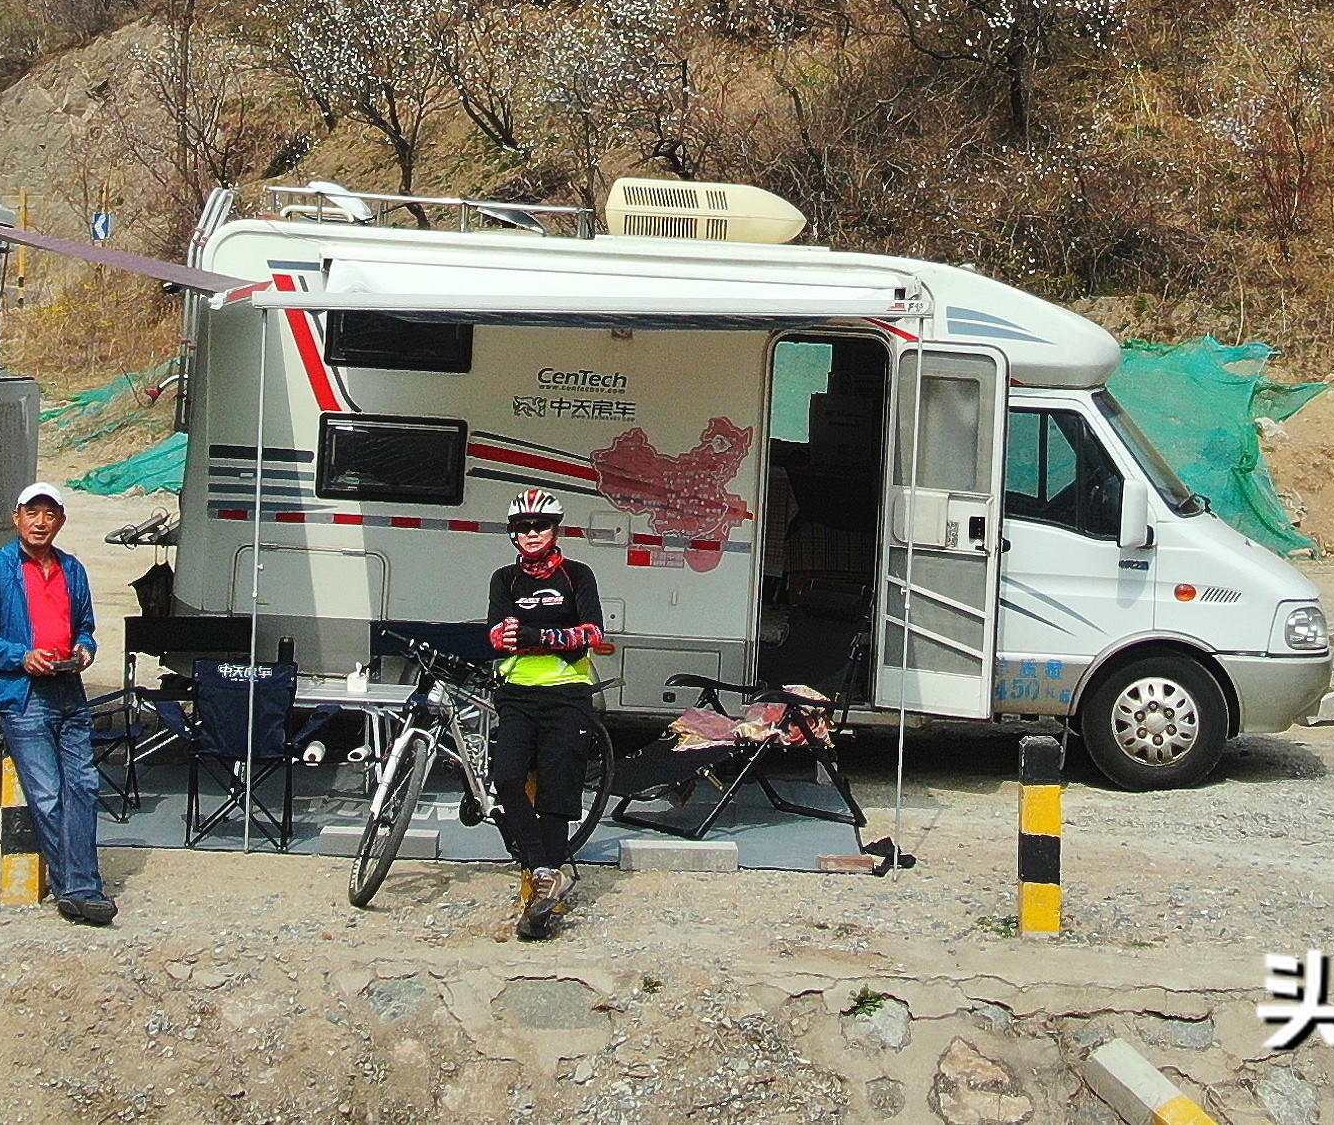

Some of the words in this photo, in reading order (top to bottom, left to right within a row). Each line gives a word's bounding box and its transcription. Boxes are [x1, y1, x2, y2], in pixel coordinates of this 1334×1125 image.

[537, 367, 627, 388] CenTech
[549, 397, 636, 417] 中天房车
